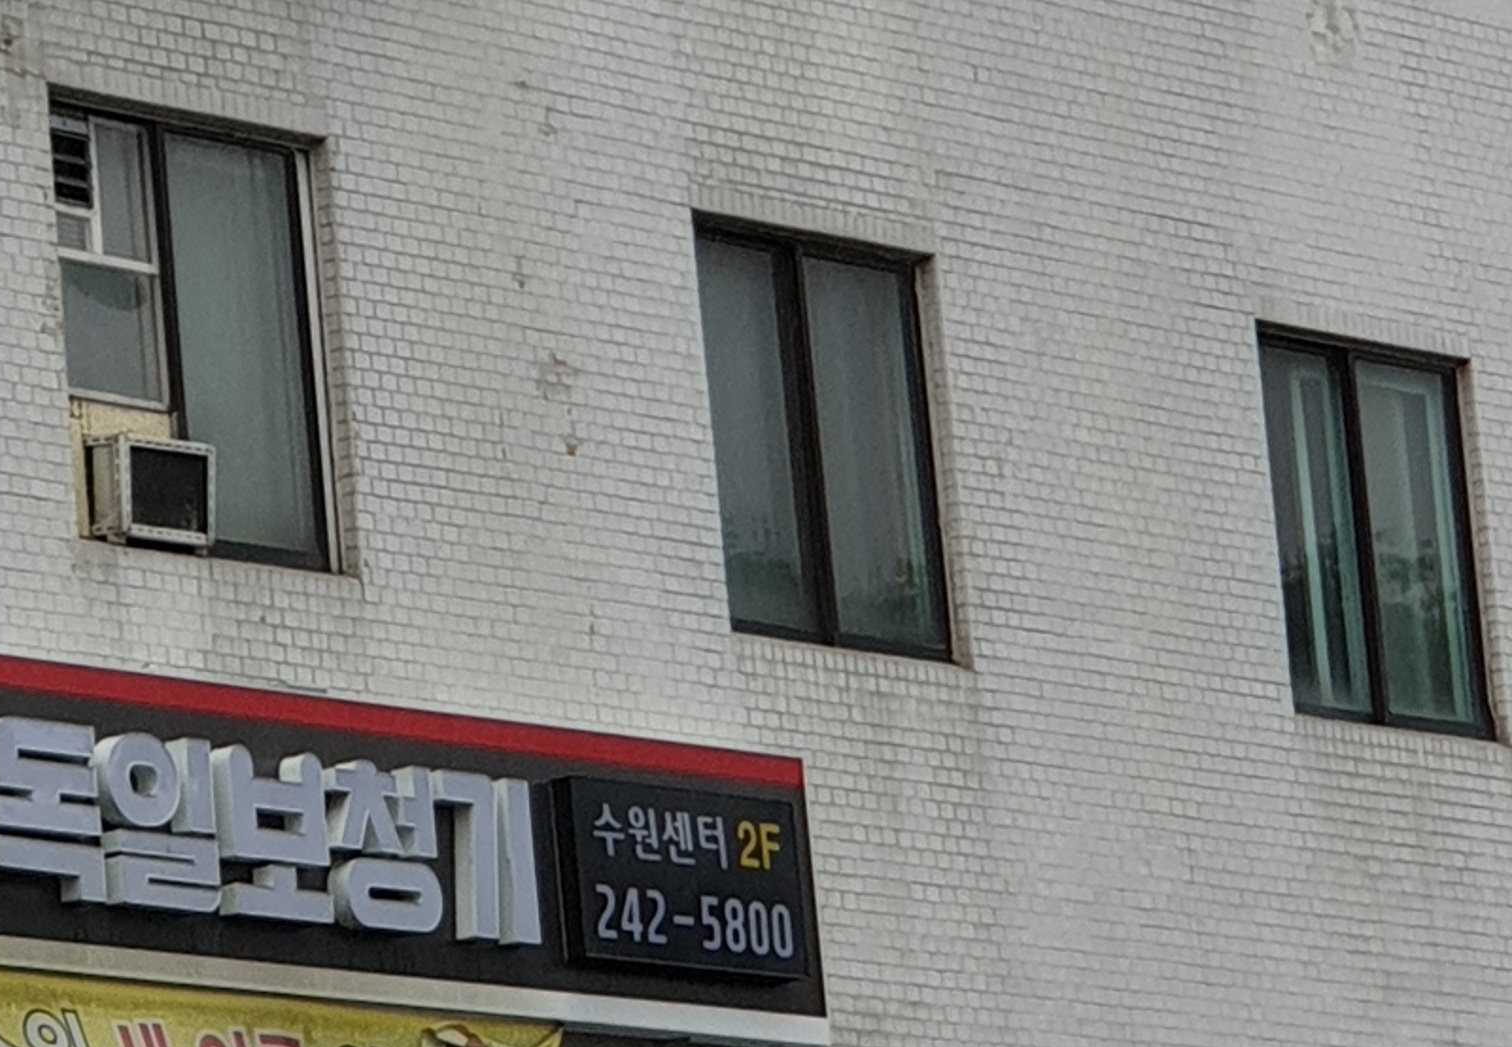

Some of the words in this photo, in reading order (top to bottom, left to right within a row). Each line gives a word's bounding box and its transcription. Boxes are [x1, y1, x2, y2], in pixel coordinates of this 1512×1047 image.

[593, 802, 729, 871] 수원센터
[737, 820, 781, 871] 2F
[595, 883, 794, 960] 242-5800
